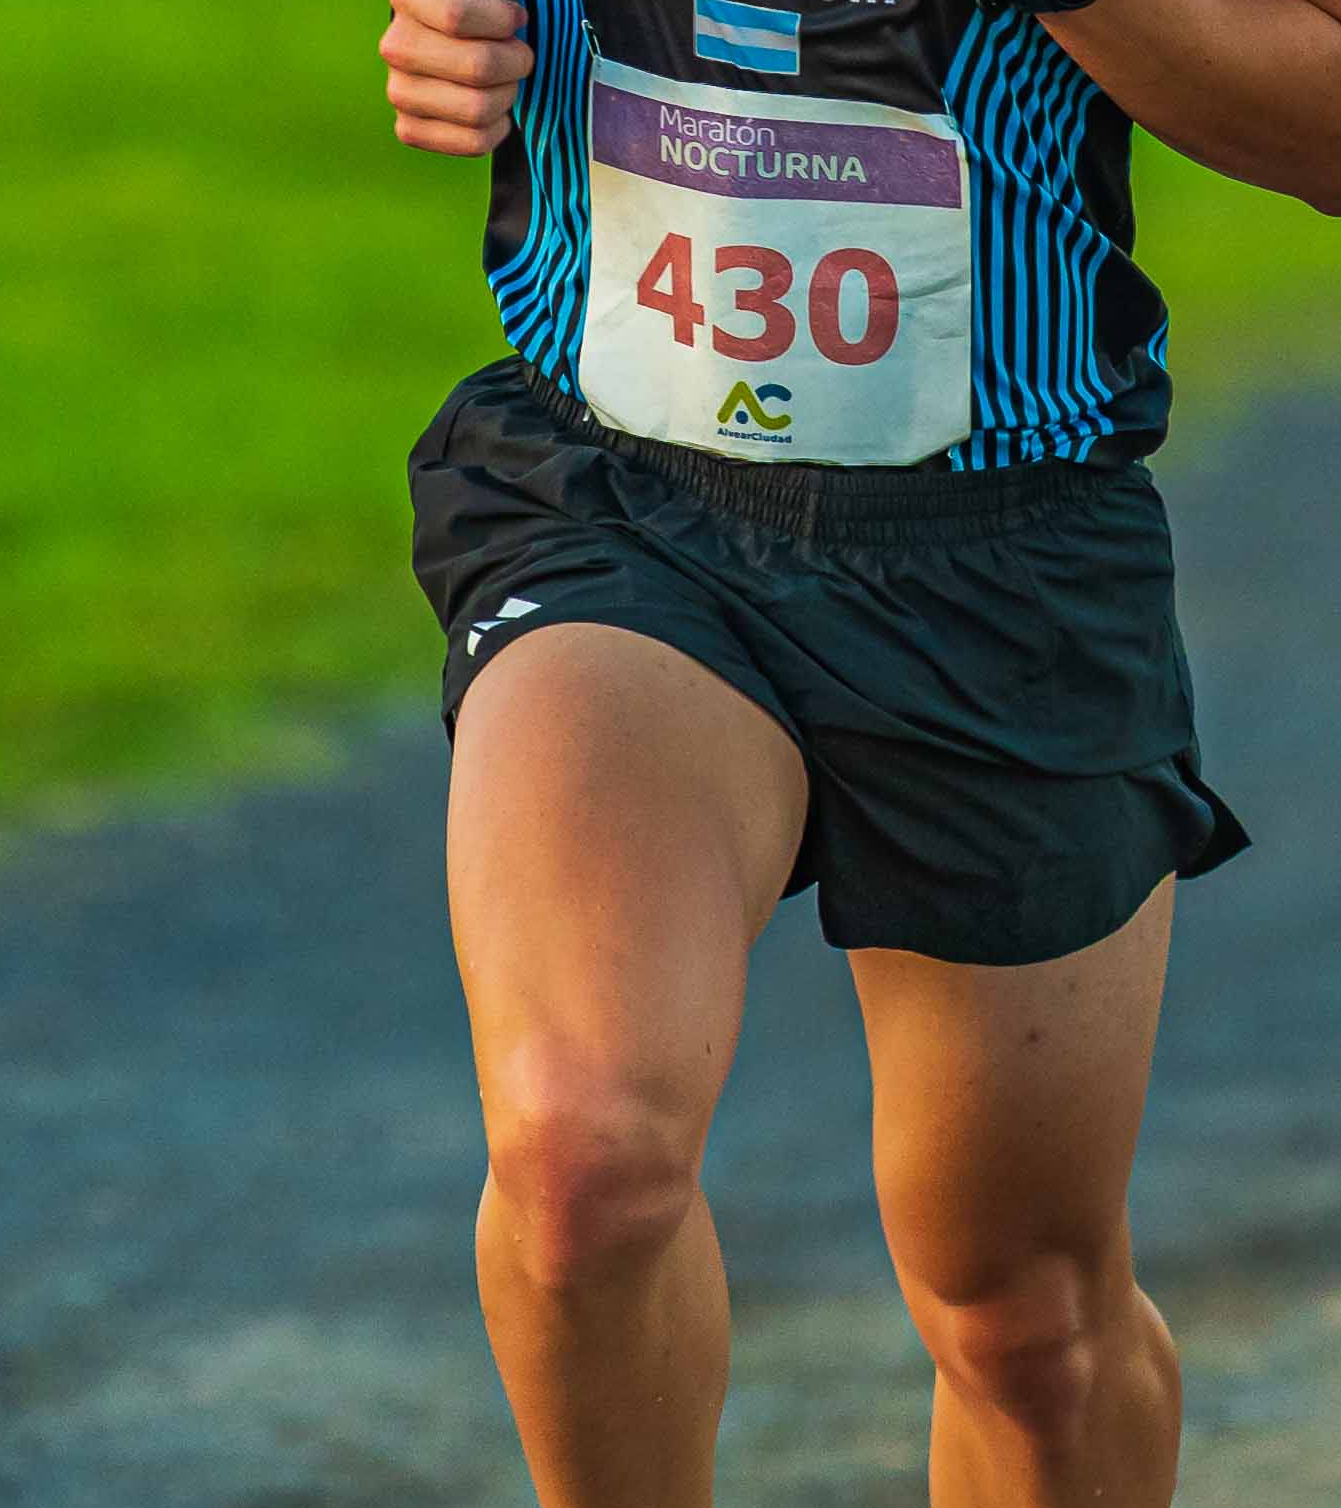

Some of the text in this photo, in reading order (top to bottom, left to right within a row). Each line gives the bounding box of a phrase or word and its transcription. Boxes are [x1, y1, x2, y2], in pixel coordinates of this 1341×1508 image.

[660, 104, 776, 147] Maratón
[660, 134, 868, 184] NOCTURNA
[636, 231, 901, 367] 430
